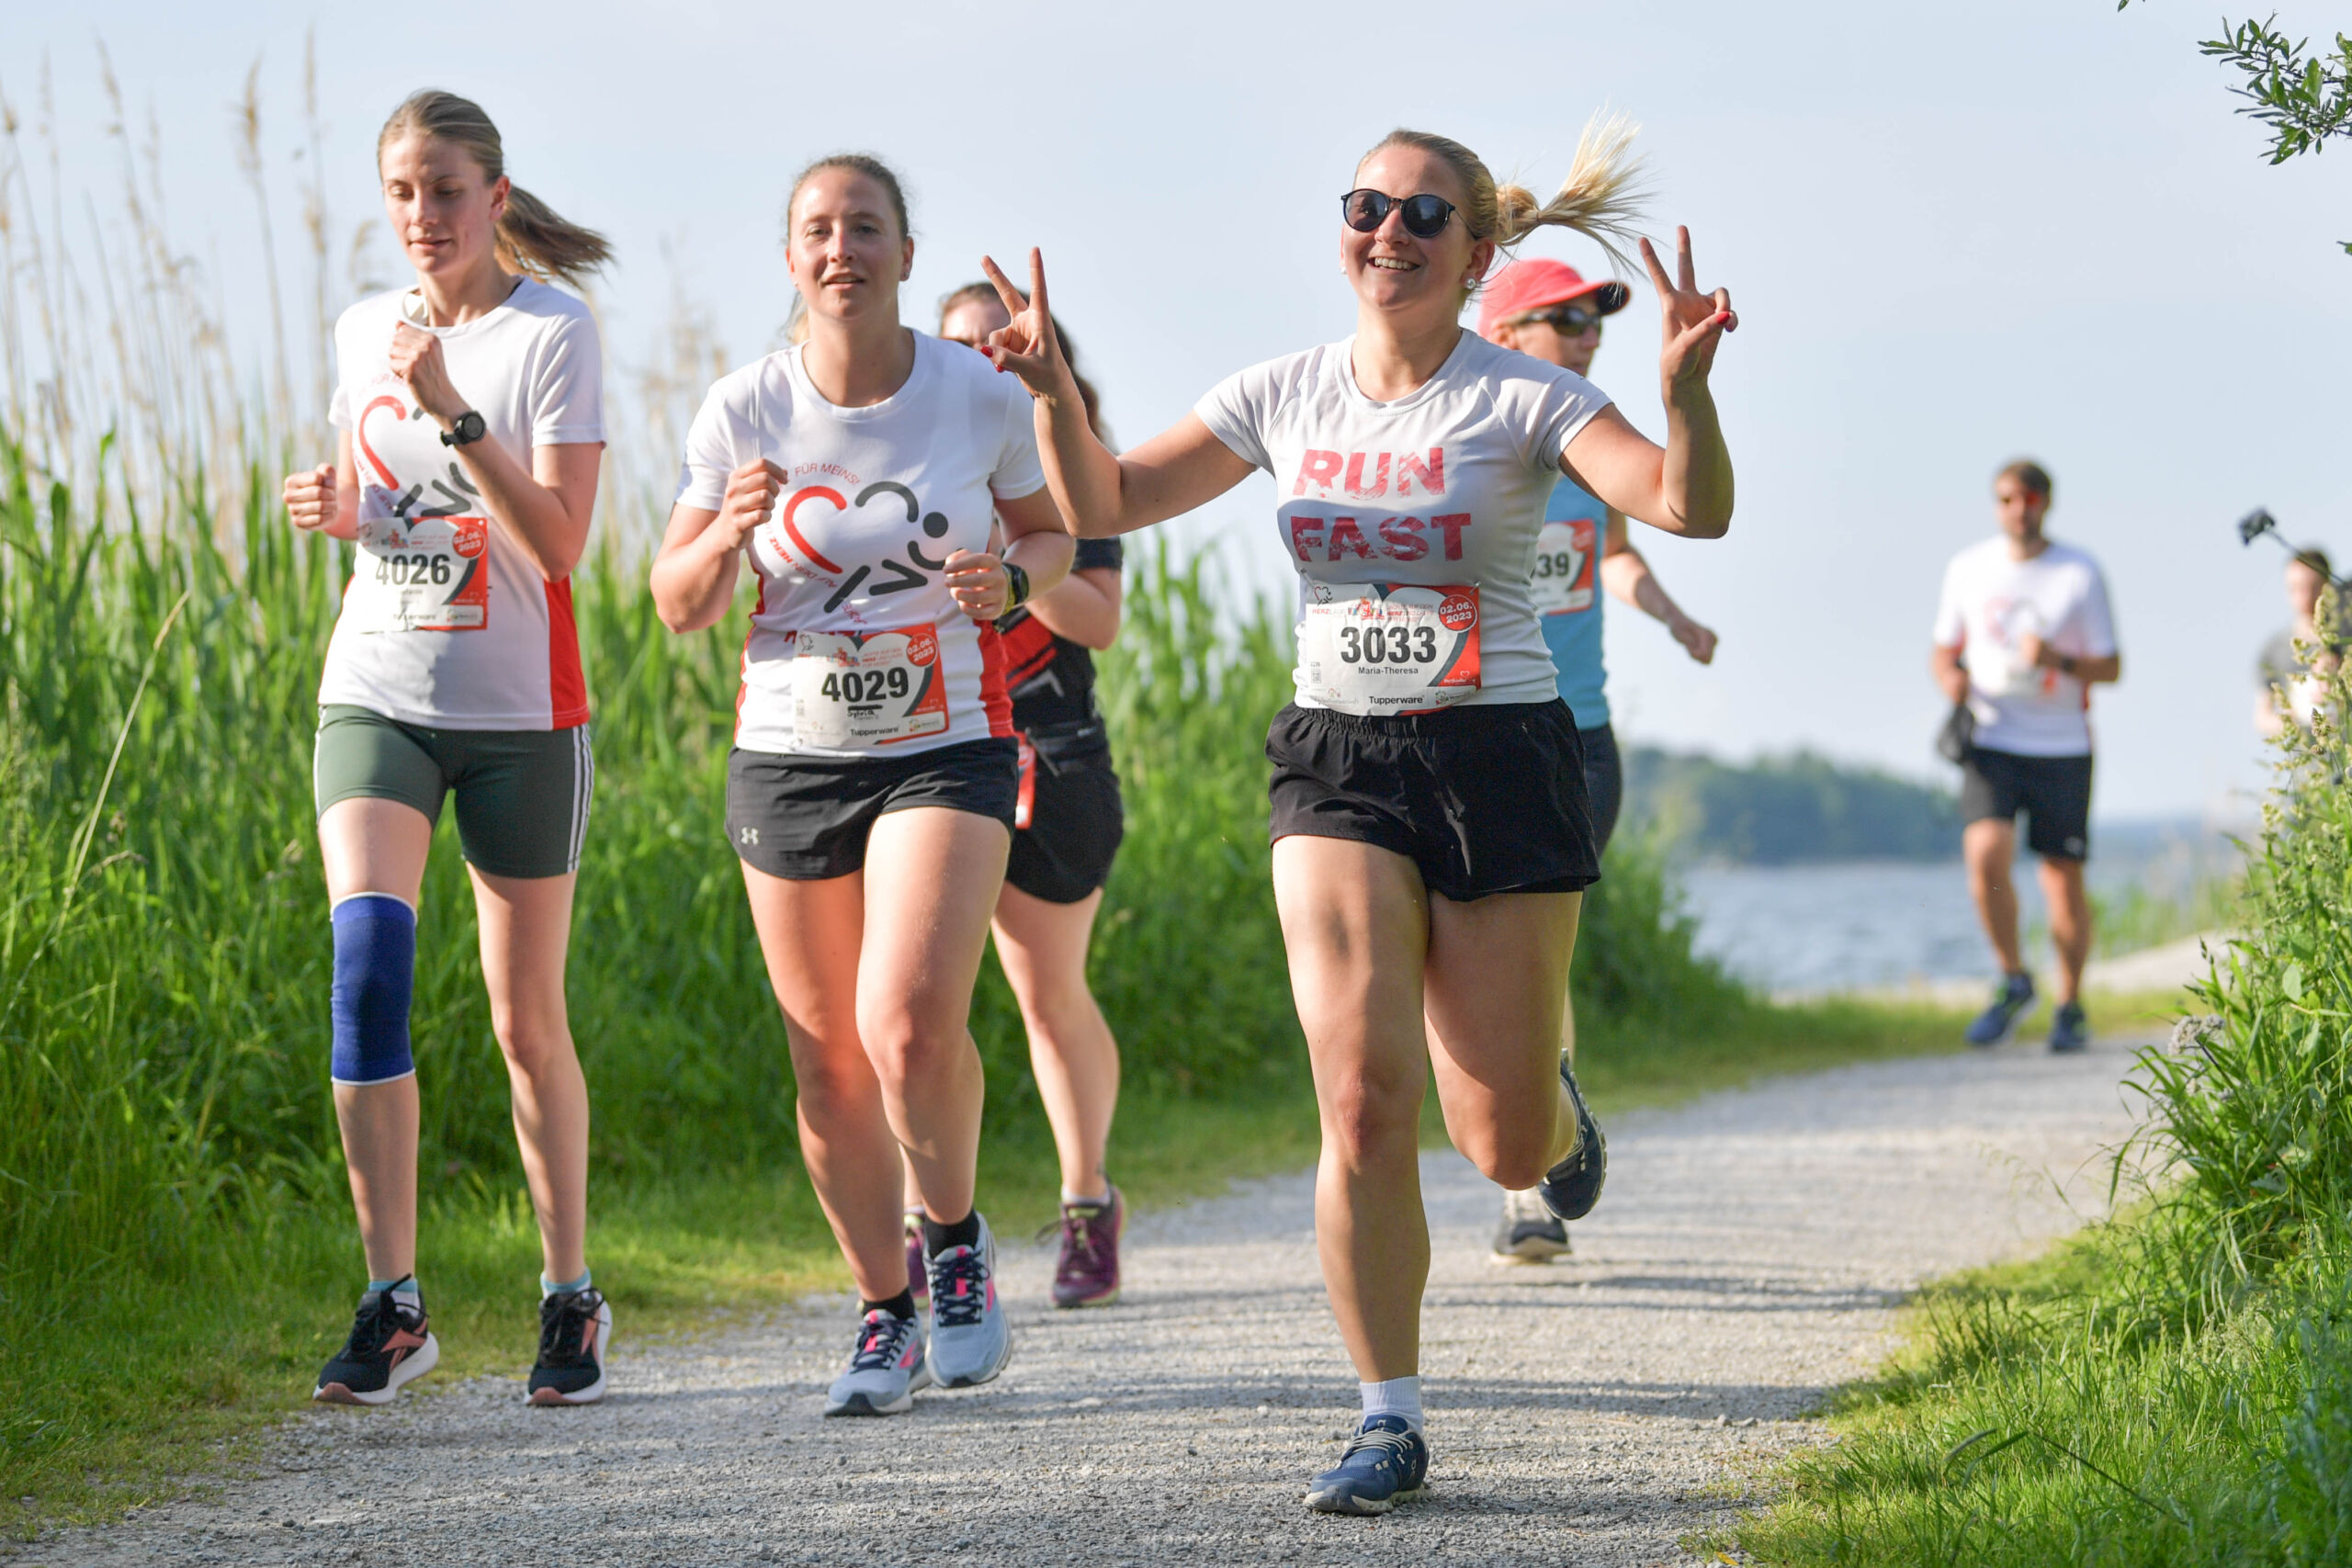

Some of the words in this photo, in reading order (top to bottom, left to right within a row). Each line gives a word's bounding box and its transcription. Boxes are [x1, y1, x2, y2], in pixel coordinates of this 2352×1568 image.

[795, 463, 818, 478] FÜR
[820, 463, 861, 486] MEINS!
[1293, 447, 1445, 499] RUN
[1291, 513, 1471, 562] FAST
[769, 536, 794, 563] HERZ
[375, 554, 451, 585] 4026
[1440, 602, 1473, 615] 02.06.
[1446, 611, 1473, 624] 2023
[907, 637, 933, 654] 02.06.
[912, 646, 934, 661] 2023
[1340, 626, 1437, 663] 3033
[1358, 666, 1419, 675] Maria-Theresa
[821, 667, 909, 703] 4029
[1369, 695, 1423, 705] Tupperware
[850, 727, 899, 736] Tupperware
